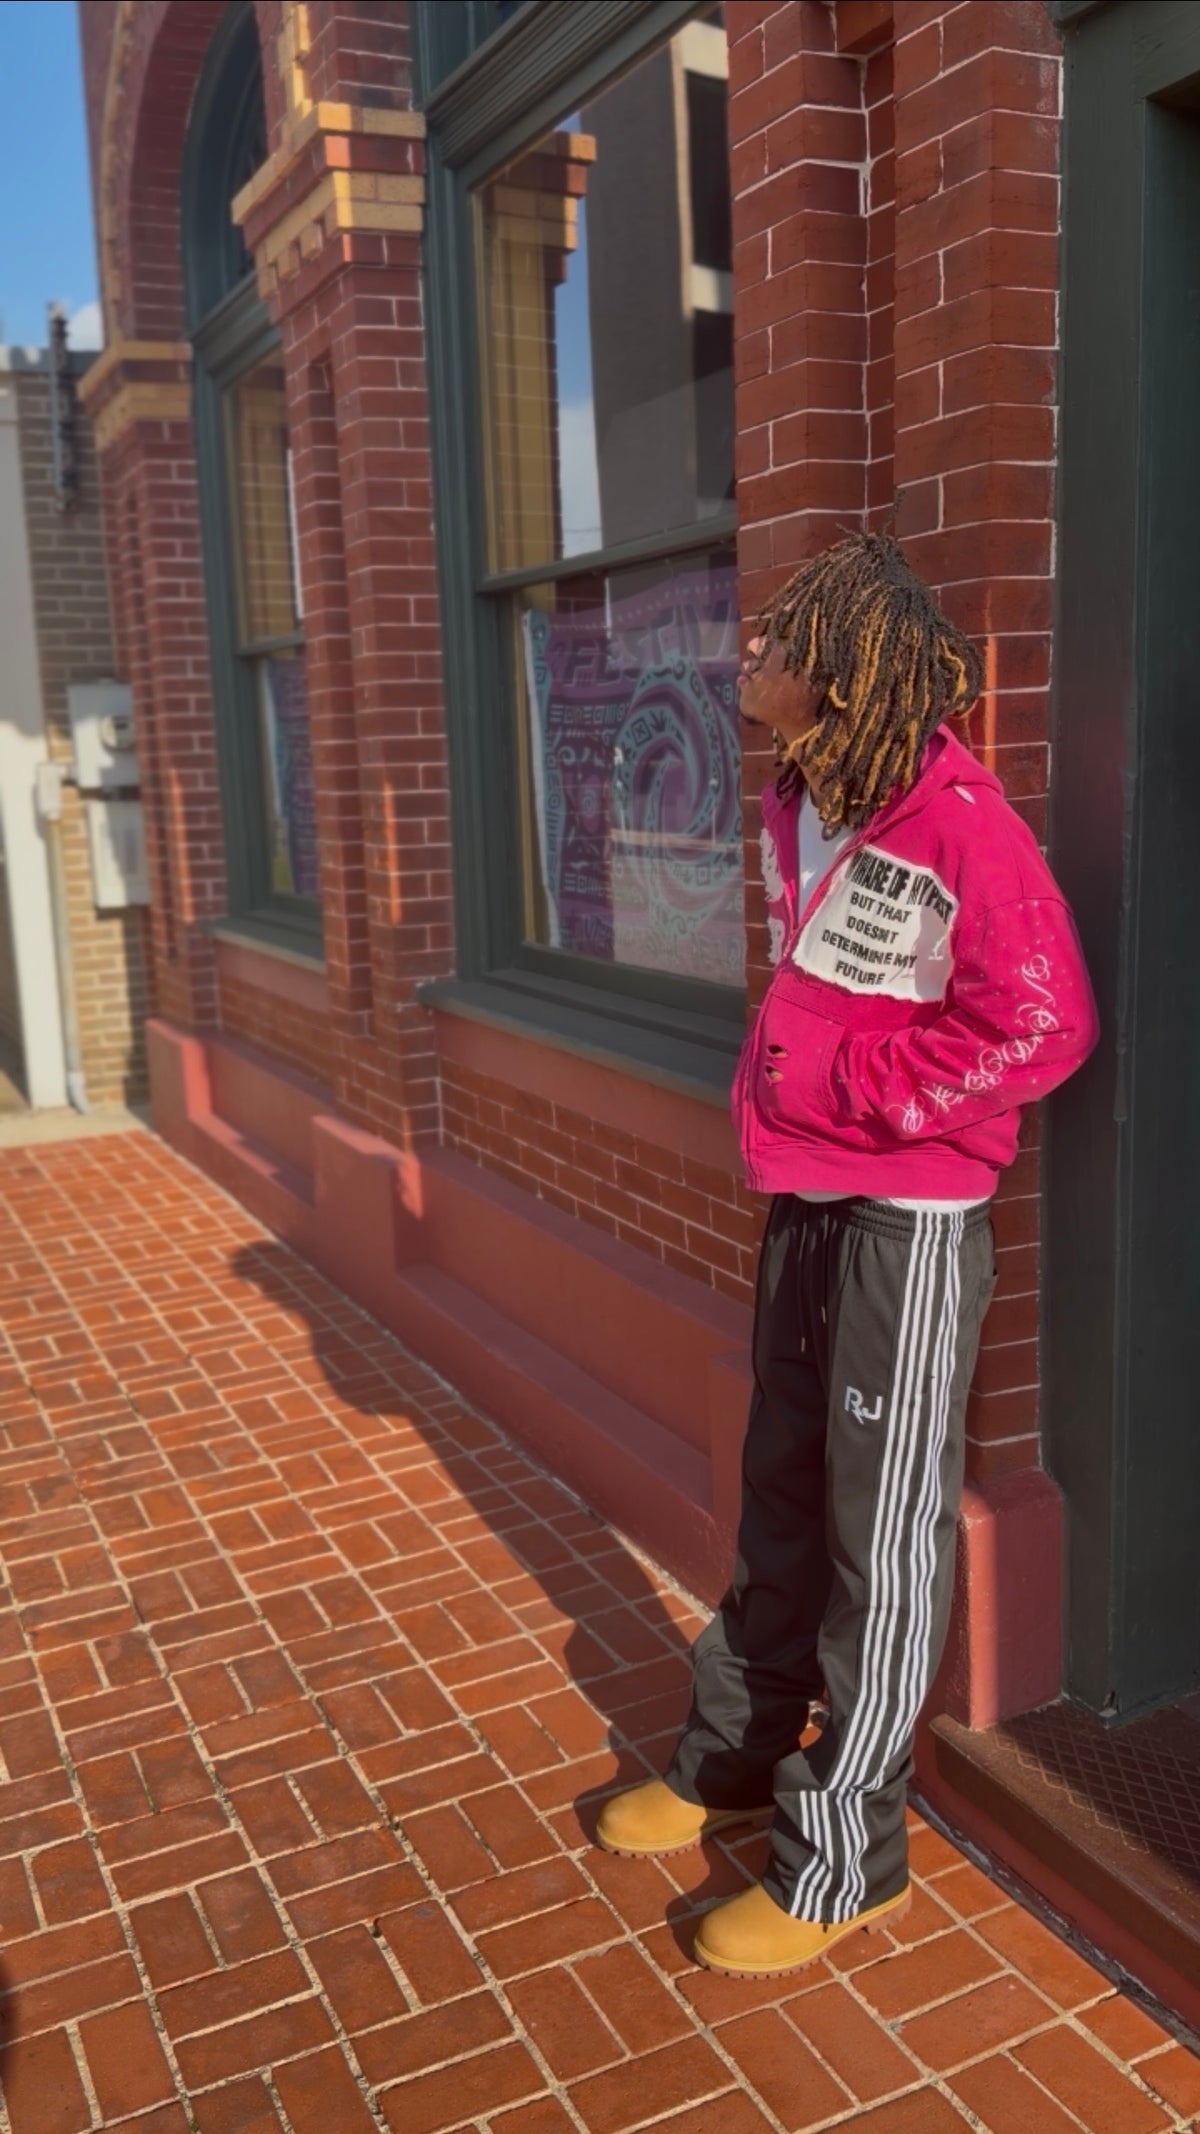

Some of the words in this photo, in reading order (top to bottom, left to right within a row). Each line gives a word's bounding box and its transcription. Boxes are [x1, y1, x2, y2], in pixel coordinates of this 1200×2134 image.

[850, 892, 875, 911] BUT
[876, 900, 912, 923] THAT
[887, 867, 910, 900] OF
[907, 874, 933, 905] MY
[925, 885, 953, 924] PAST
[822, 930, 893, 965] DETERMINE
[893, 952, 917, 968] MY
[835, 961, 885, 985] FUTURE
